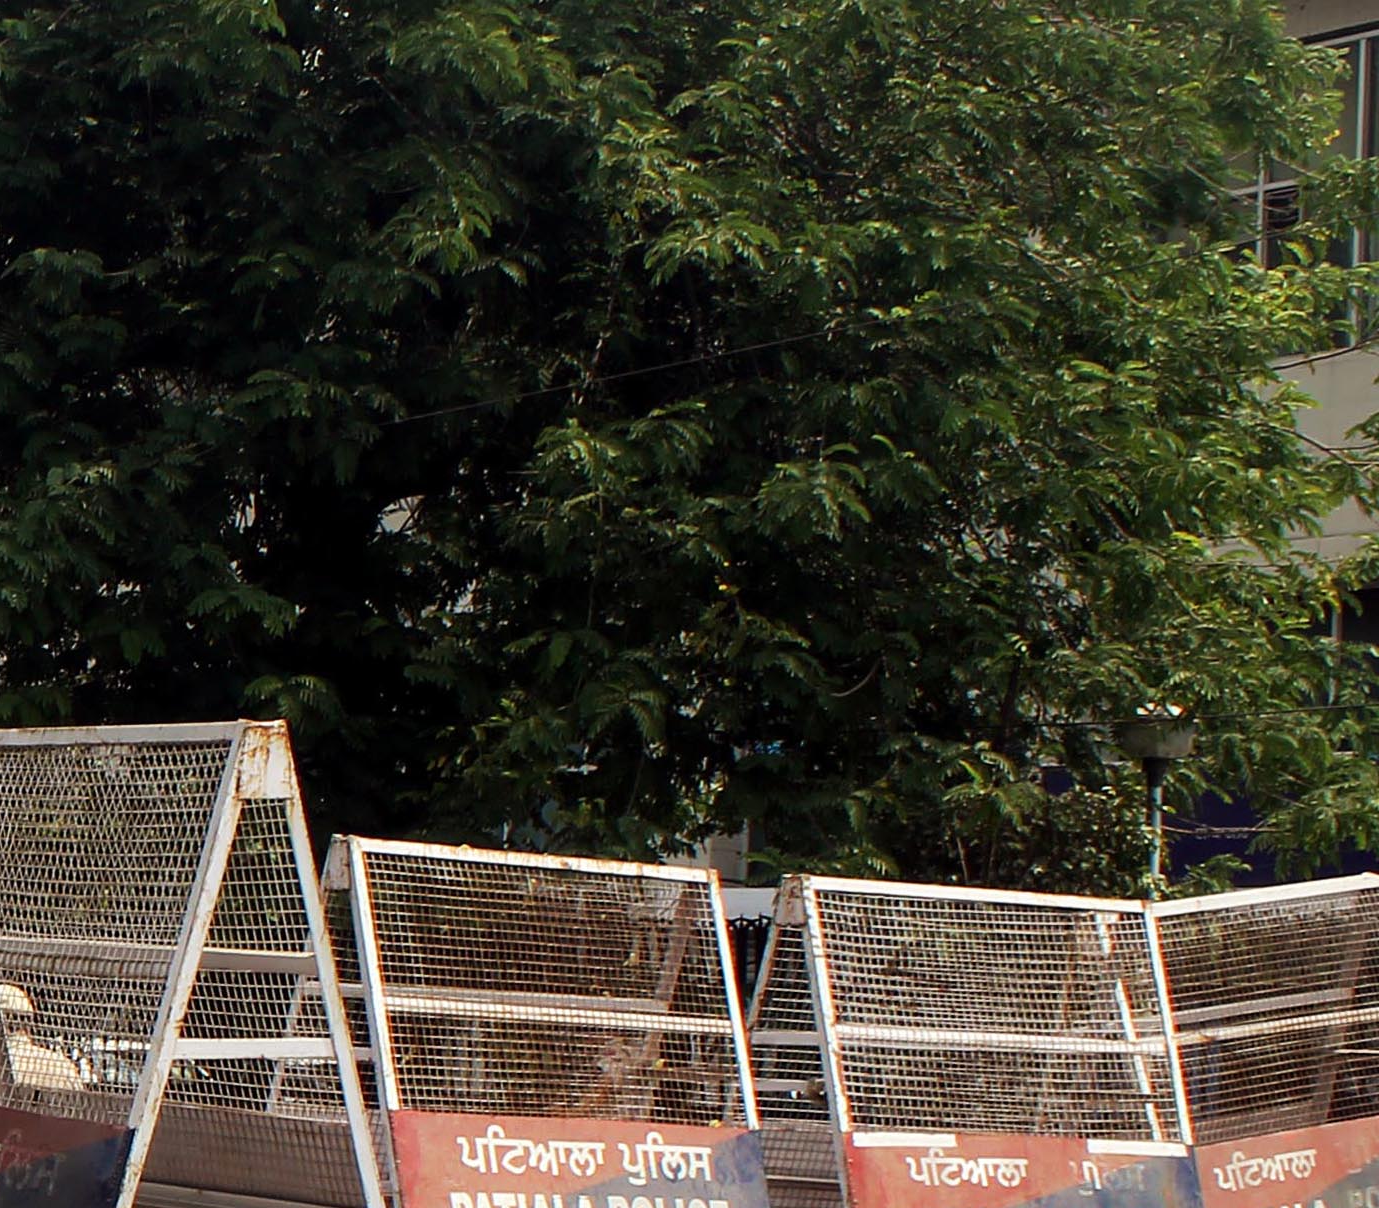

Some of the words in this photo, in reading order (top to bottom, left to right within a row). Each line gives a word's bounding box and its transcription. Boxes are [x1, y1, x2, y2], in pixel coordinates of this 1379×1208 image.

[456, 1125, 606, 1178] ਪਟਿਆਲਾ
[618, 1131, 712, 1186] ਪੁਲਿਸ
[906, 1148, 1029, 1188] ਪਟਿਆਲਾ
[1213, 1149, 1318, 1191] ਪਟਿਆਲਾ
